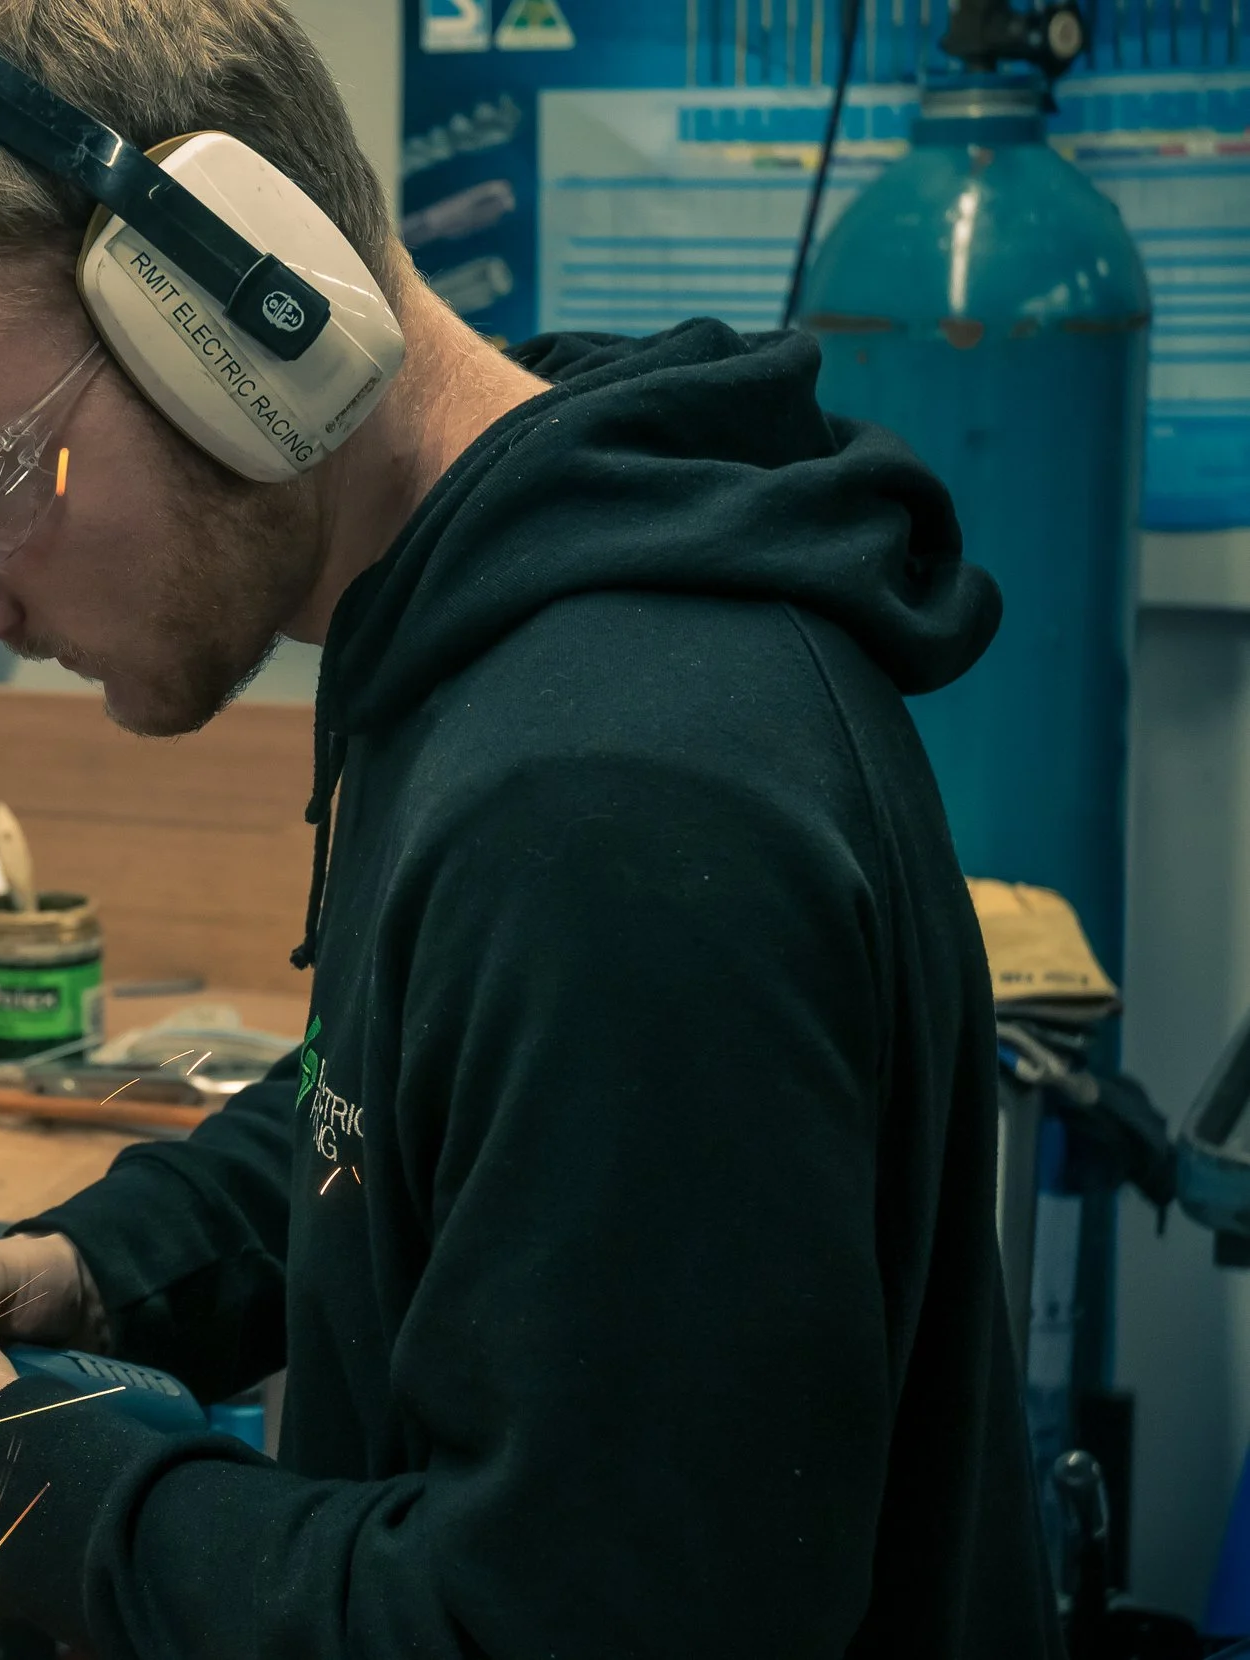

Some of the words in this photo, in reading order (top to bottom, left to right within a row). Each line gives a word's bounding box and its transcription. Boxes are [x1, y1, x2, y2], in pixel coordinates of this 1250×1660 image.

[130, 251, 180, 303] RMIT
[172, 302, 256, 397] ELECTRIC
[250, 395, 313, 463] RACING
